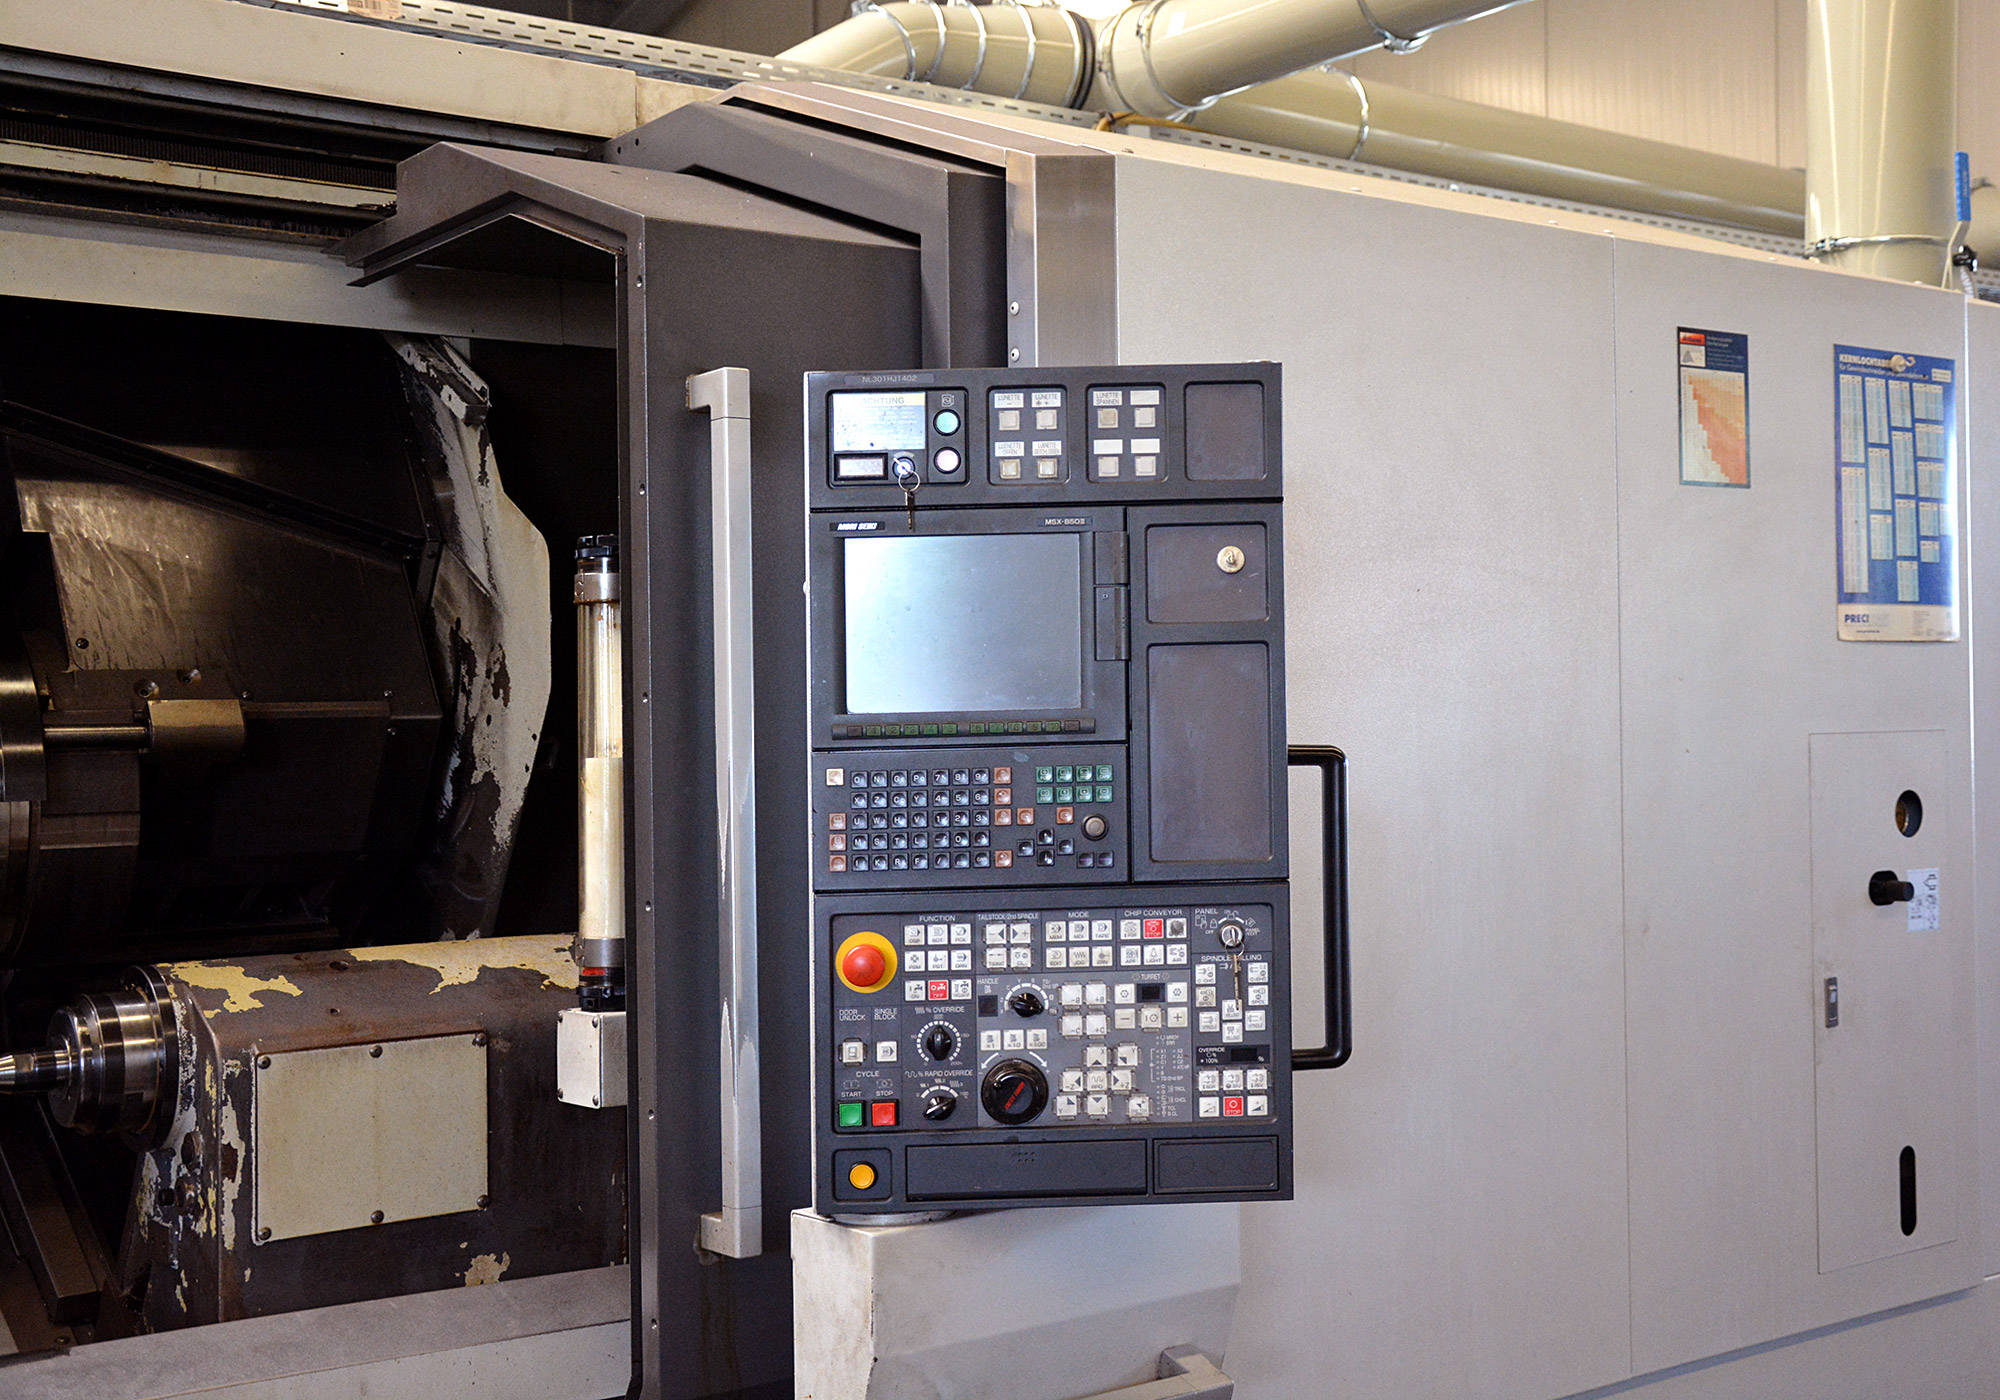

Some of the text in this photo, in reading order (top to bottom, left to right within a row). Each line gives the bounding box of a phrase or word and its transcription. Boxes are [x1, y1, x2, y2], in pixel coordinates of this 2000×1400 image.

[913, 774, 920, 782] P
[934, 774, 941, 782] 7
[954, 773, 961, 781] 8
[893, 796, 901, 804] C
[955, 794, 961, 802] 5
[974, 793, 981, 801] 6
[853, 818, 860, 826] U
[894, 816, 901, 824] H
[913, 815, 920, 823] V
[936, 814, 982, 823] 1 2 3
[854, 837, 920, 846] M S T L
[874, 859, 881, 867] K
[894, 858, 901, 866] R
[914, 857, 920, 865] F
[1068, 911, 1090, 919] MODE
[1143, 909, 1183, 917] CONVEYOR
[919, 914, 956, 922] FUNCTION
[977, 977, 999, 985] HANDLE
[944, 1069, 974, 1077] OVERRIDE
